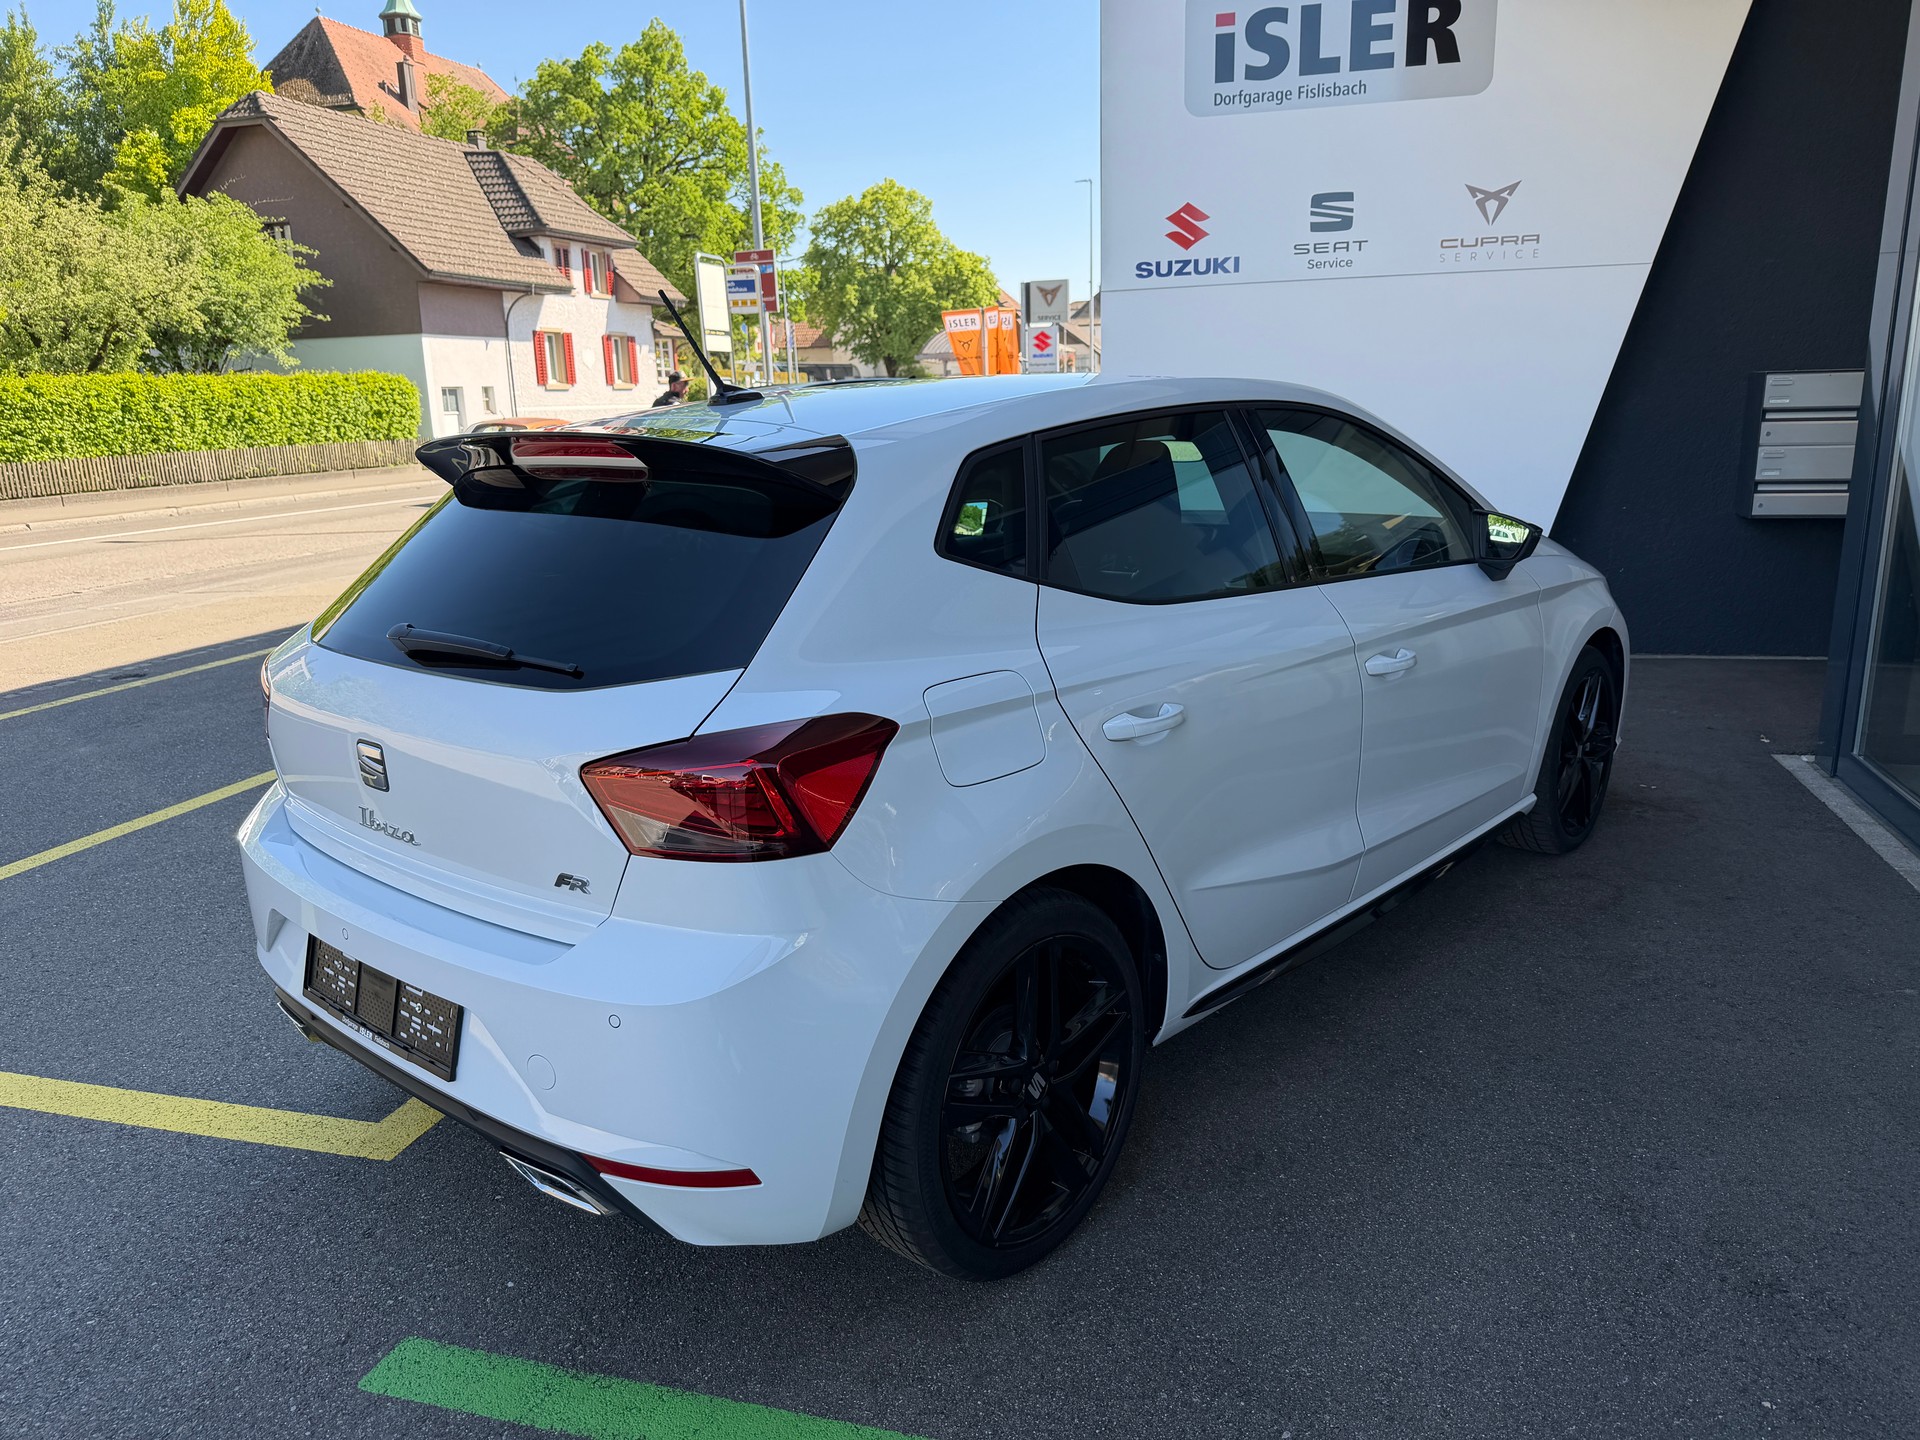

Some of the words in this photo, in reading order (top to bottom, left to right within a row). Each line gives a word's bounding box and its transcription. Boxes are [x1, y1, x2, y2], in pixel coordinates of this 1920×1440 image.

[1214, 87, 1293, 108] Dorfgarage
[1298, 80, 1367, 100] Fislisbach
[1293, 240, 1369, 256] SEAT
[1440, 233, 1540, 249] CUPRA
[1307, 257, 1353, 270] Service
[1440, 248, 1540, 263] SERVICE
[1135, 256, 1241, 279] SUZUKI
[358, 804, 422, 847] Ibiza
[554, 872, 592, 895] FR
